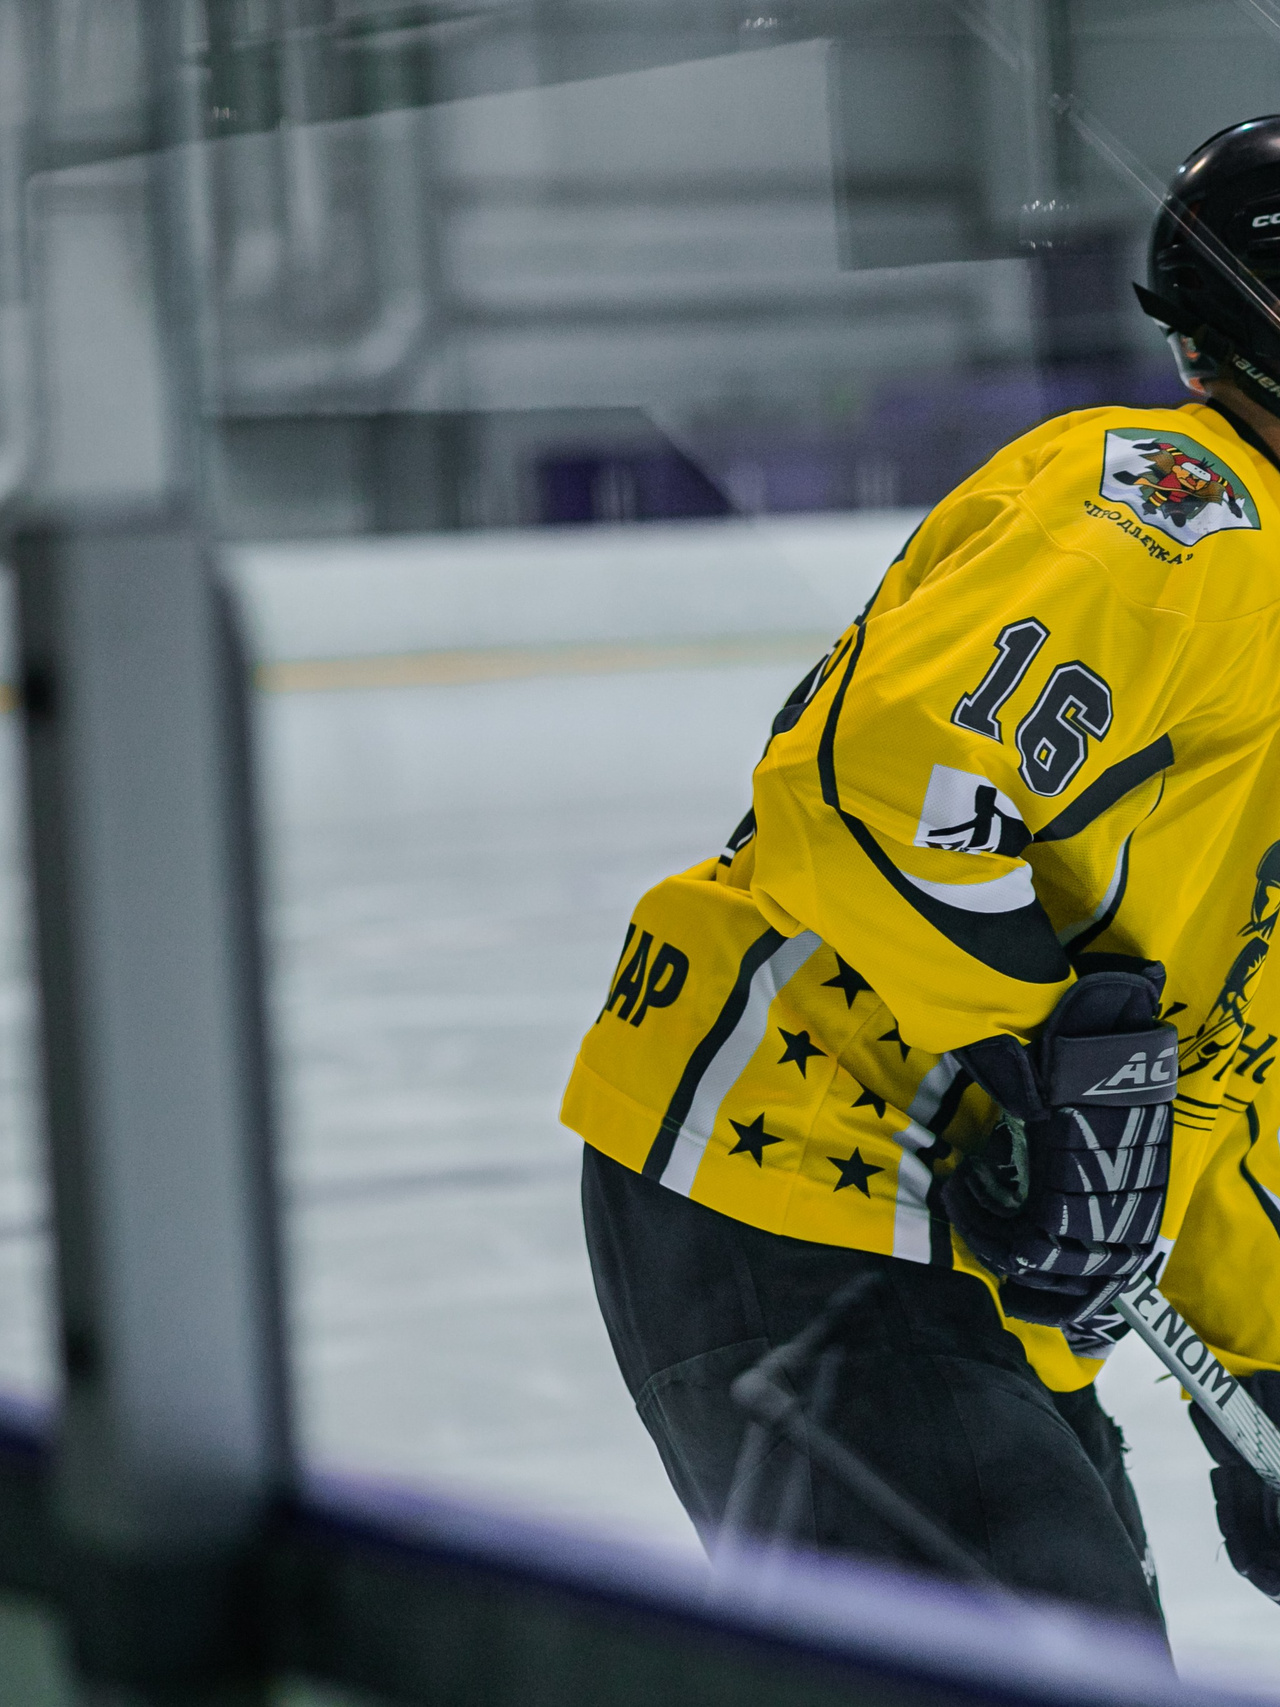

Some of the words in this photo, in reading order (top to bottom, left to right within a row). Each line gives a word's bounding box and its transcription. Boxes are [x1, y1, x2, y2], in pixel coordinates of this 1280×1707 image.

[950, 615, 1114, 797] 16
[596, 922, 690, 1028] АР
[1105, 1046, 1178, 1087] AC
